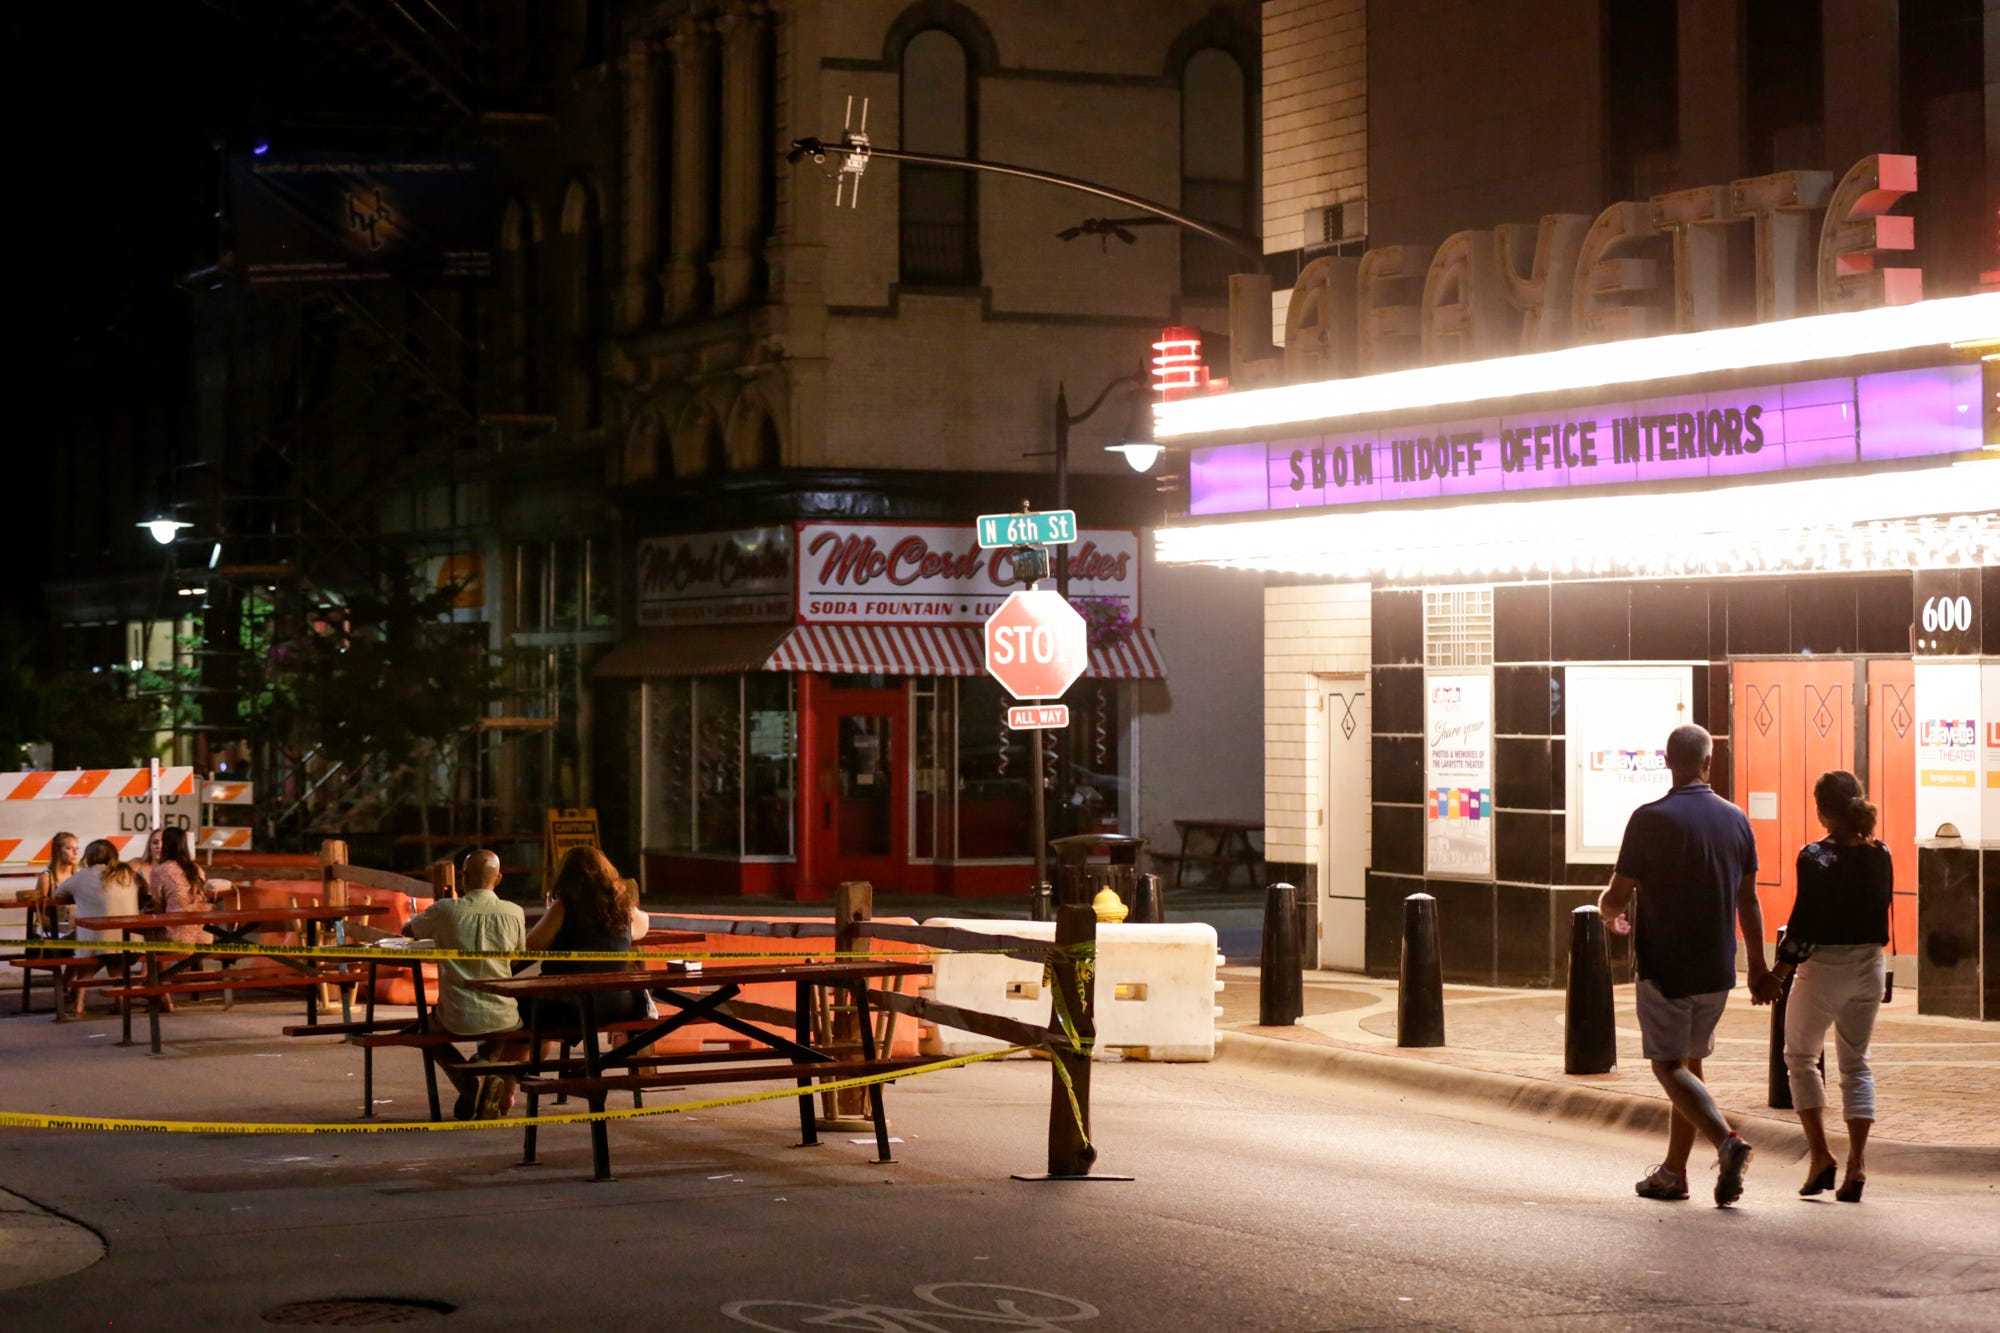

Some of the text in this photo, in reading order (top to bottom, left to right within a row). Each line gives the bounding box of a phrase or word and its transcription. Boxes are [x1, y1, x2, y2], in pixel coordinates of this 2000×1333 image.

[1229, 153, 1922, 391] LAFAYETTE
[1392, 431, 1483, 483] INDOFF
[1500, 421, 1597, 473] OFFICE
[1612, 404, 1764, 464] INTERIORS
[985, 515, 1069, 543] N 6th St
[808, 531, 1131, 586] McCord Cdies
[809, 601, 953, 616] SODA FOUNTAIN
[1922, 596, 1972, 632] 600
[993, 625, 1072, 664] STO
[1015, 710, 1063, 724] ALL WAY
[1938, 749, 1976, 762] THEATER
